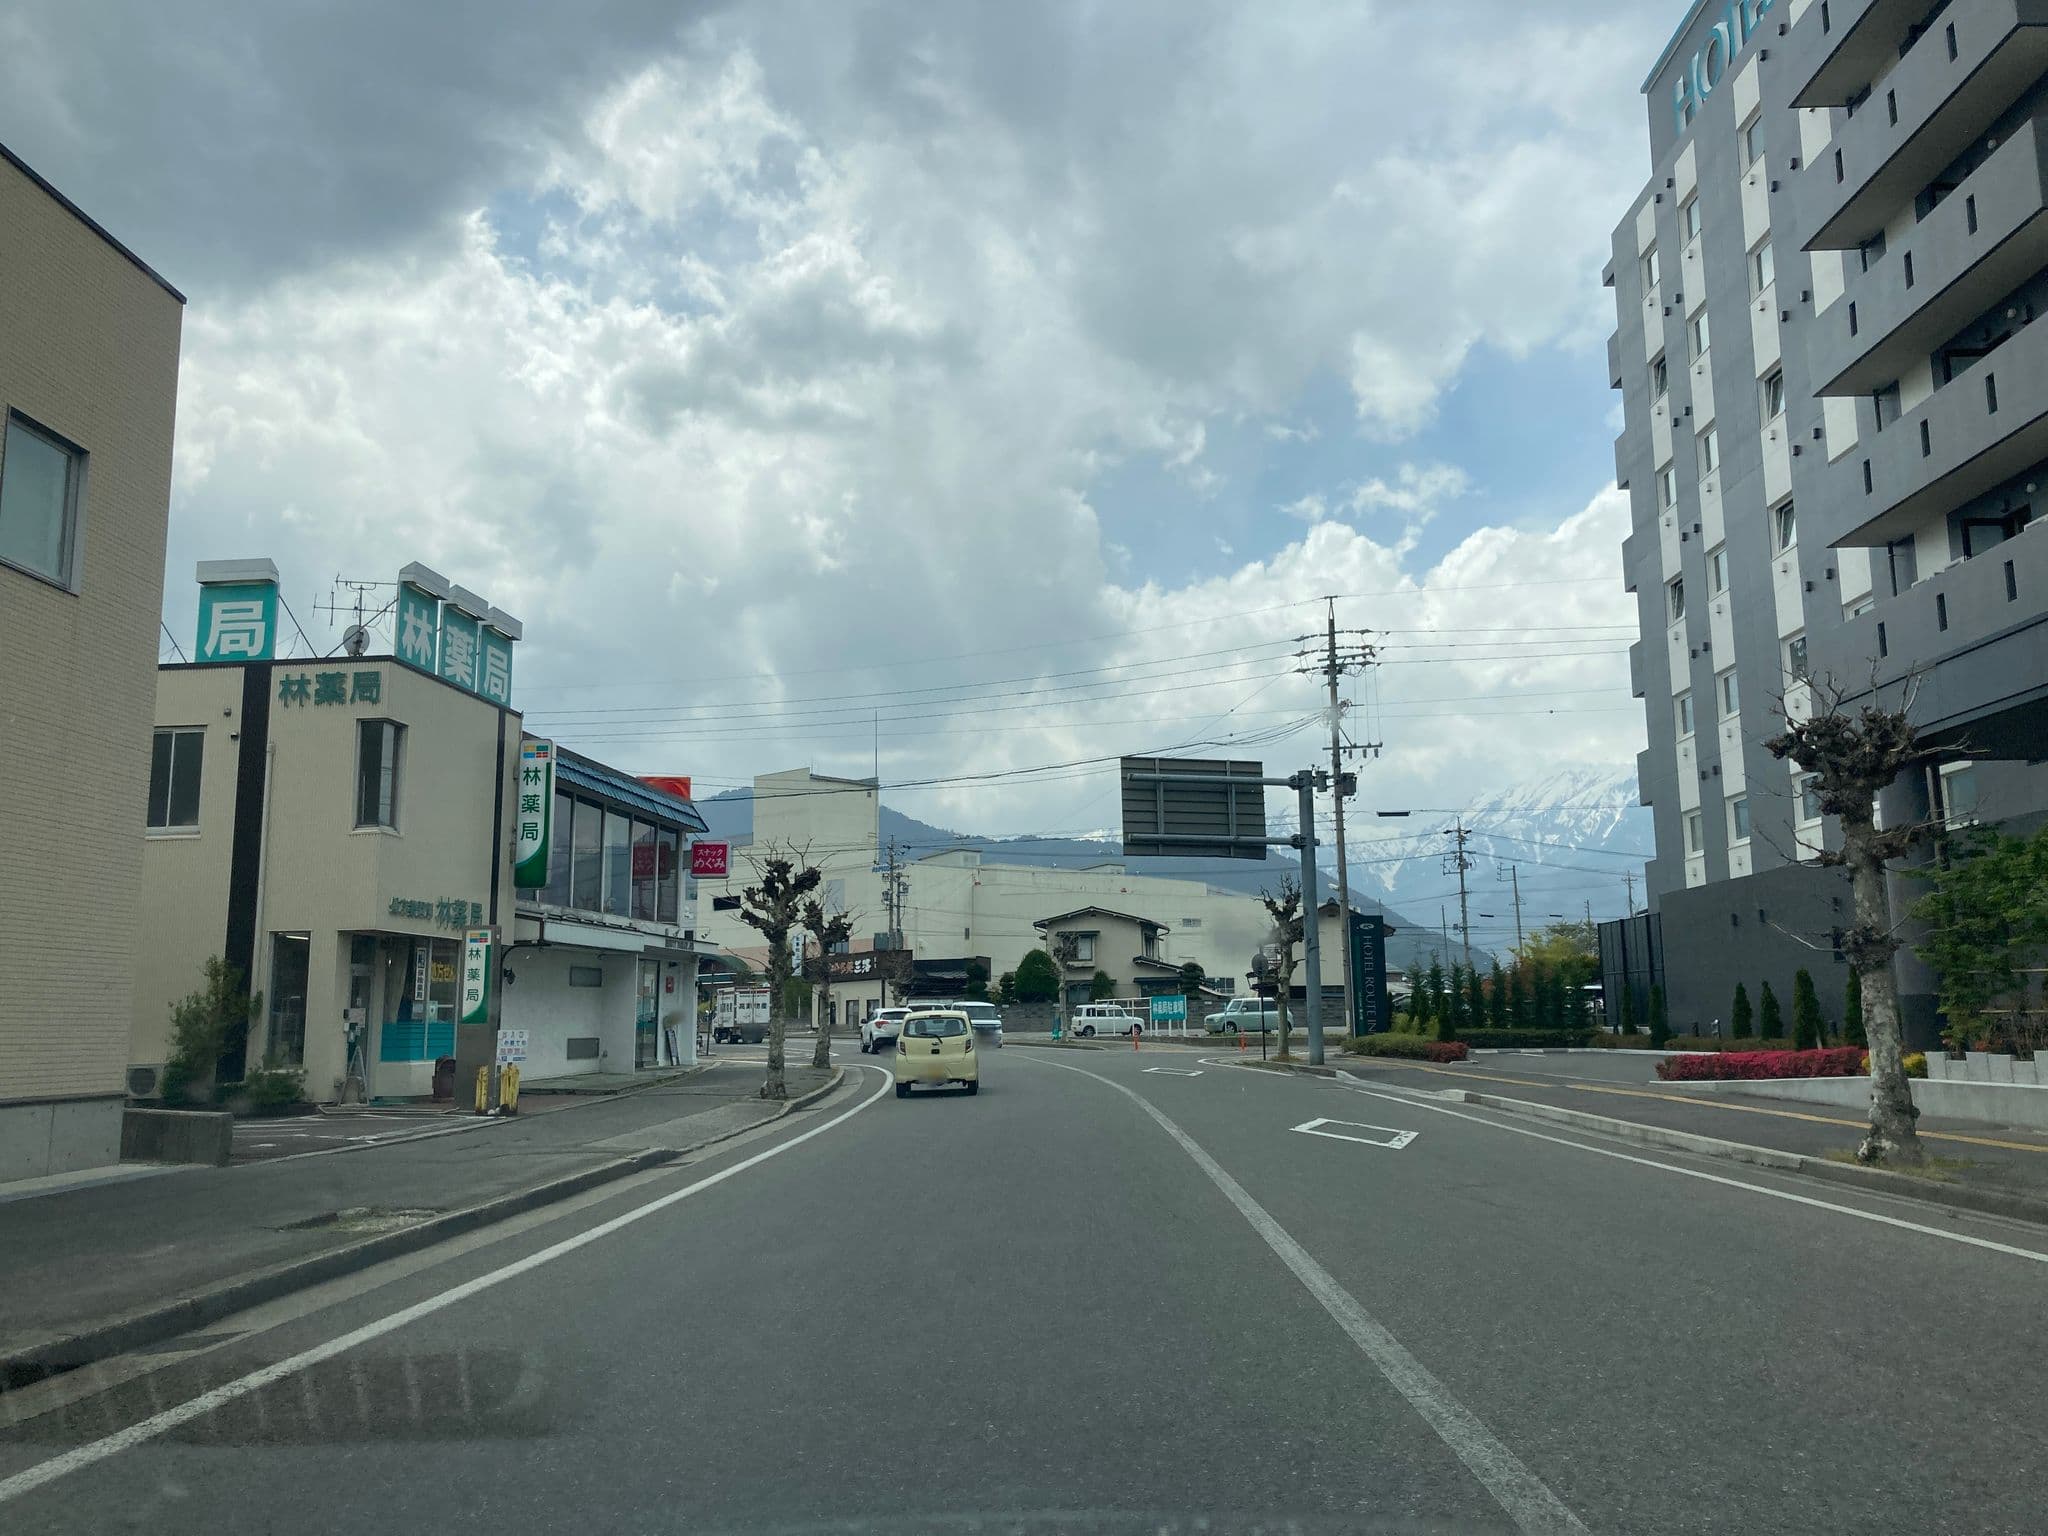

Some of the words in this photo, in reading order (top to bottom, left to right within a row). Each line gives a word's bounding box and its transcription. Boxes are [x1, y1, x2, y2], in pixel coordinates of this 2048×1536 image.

[402, 602, 510, 703] 林薬局
[278, 671, 384, 707] 林薬局
[520, 766, 541, 841] 林薬局
[693, 858, 725, 869] めぐみ
[697, 848, 723, 857] スナック
[1363, 935, 1374, 973] HOTEL
[466, 947, 481, 1002] 林薬局
[1365, 976, 1377, 1016] ROUTE
